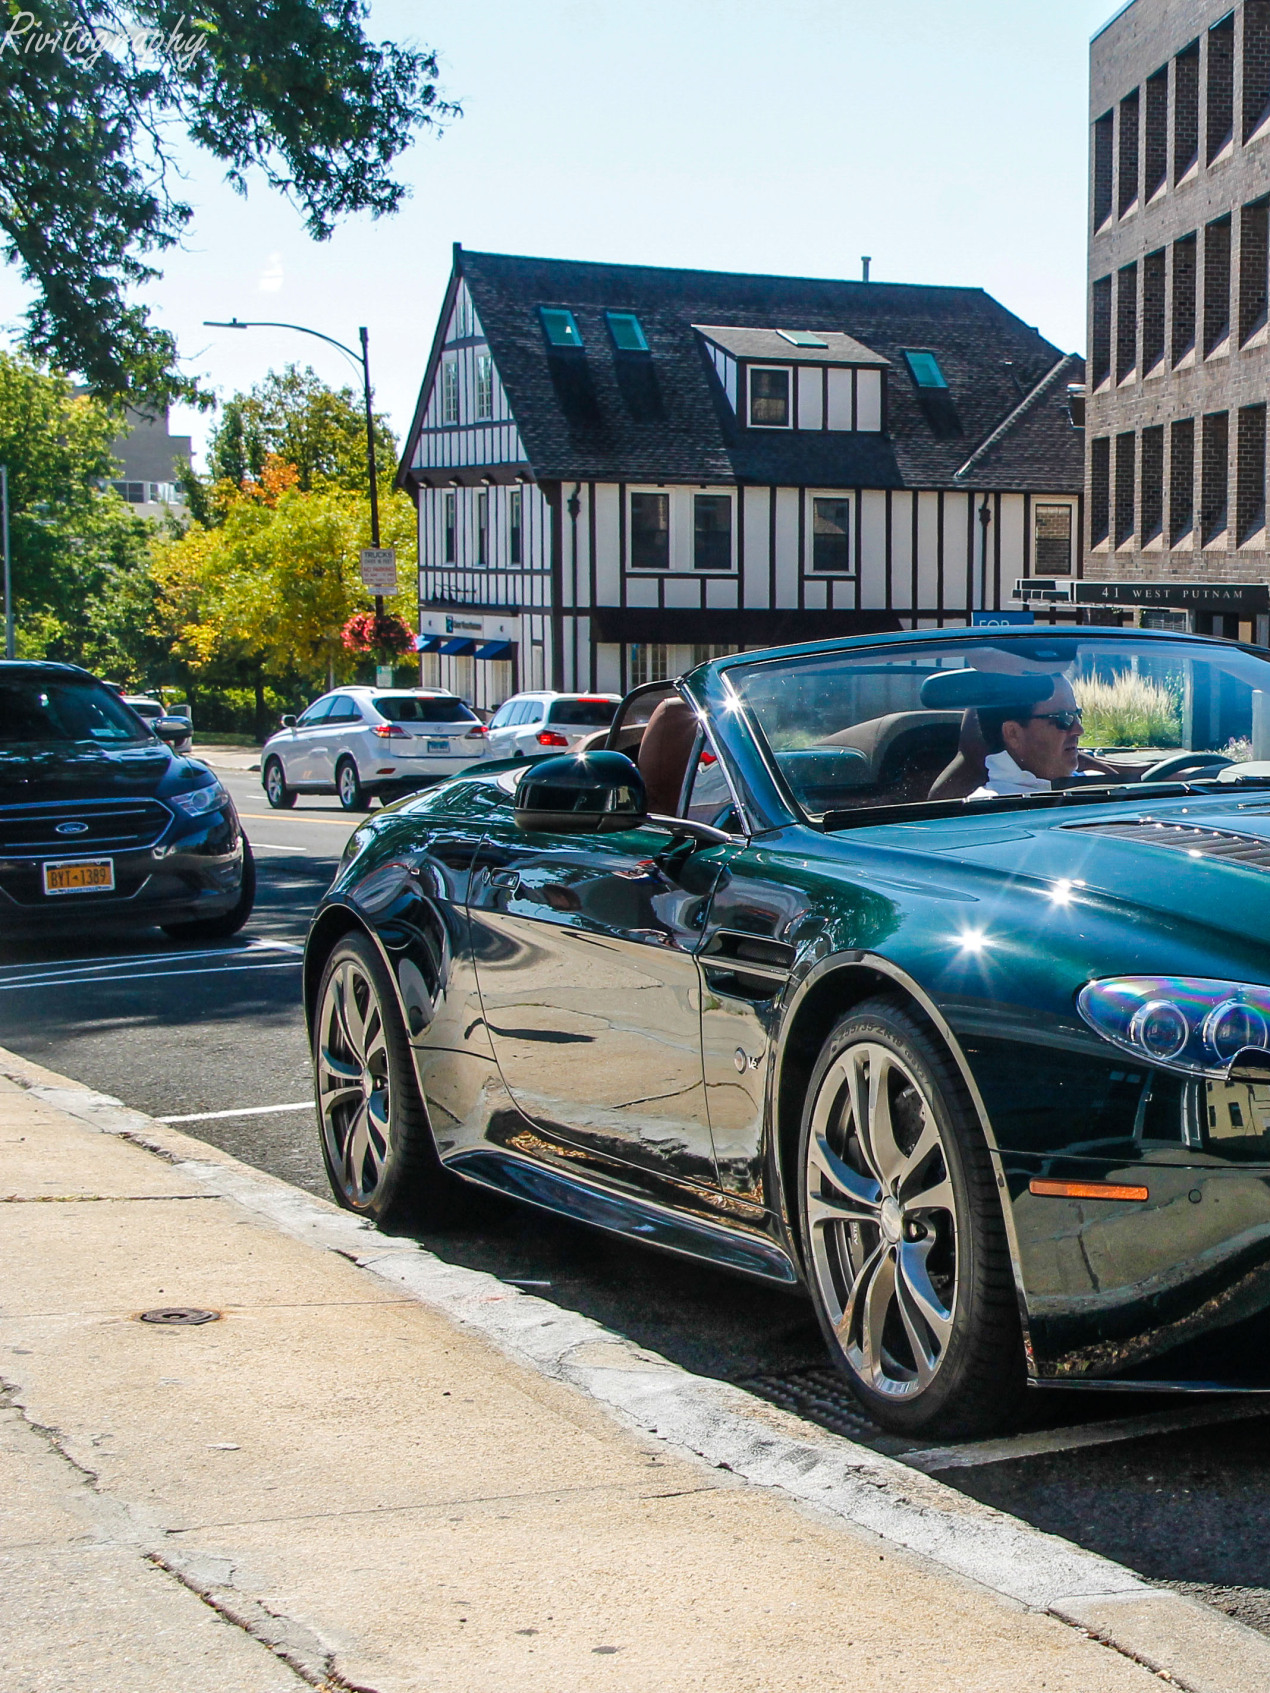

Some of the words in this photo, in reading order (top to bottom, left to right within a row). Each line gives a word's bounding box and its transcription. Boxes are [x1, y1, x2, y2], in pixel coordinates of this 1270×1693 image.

[1102, 587, 1120, 598] 41
[1132, 589, 1171, 598] WEST
[1182, 590, 1243, 599] PUTNAM
